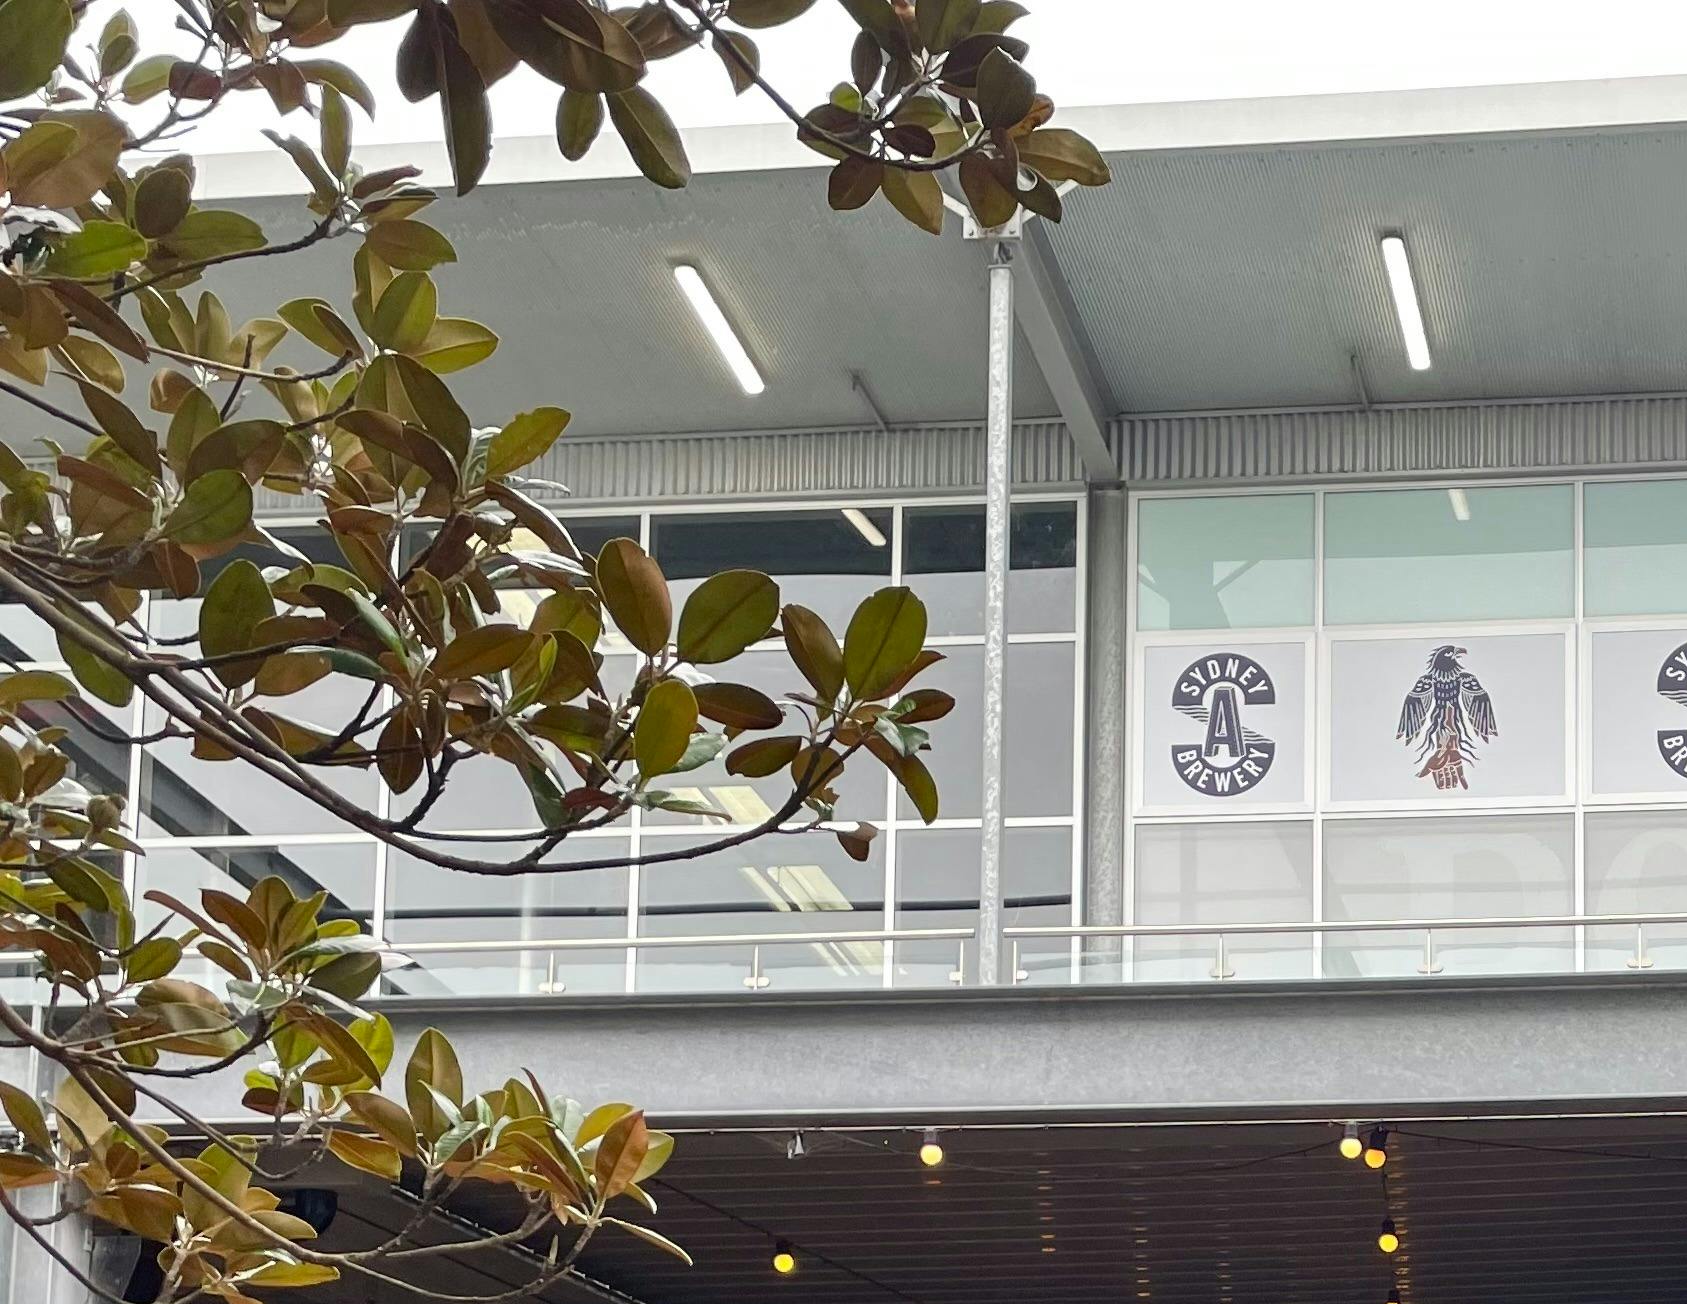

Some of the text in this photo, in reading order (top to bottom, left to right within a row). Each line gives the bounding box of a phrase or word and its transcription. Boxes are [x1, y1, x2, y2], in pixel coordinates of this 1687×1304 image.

[1180, 657, 1269, 697] SYDNEY
[1203, 686, 1246, 758] A
[1177, 748, 1270, 793] BREWERY
